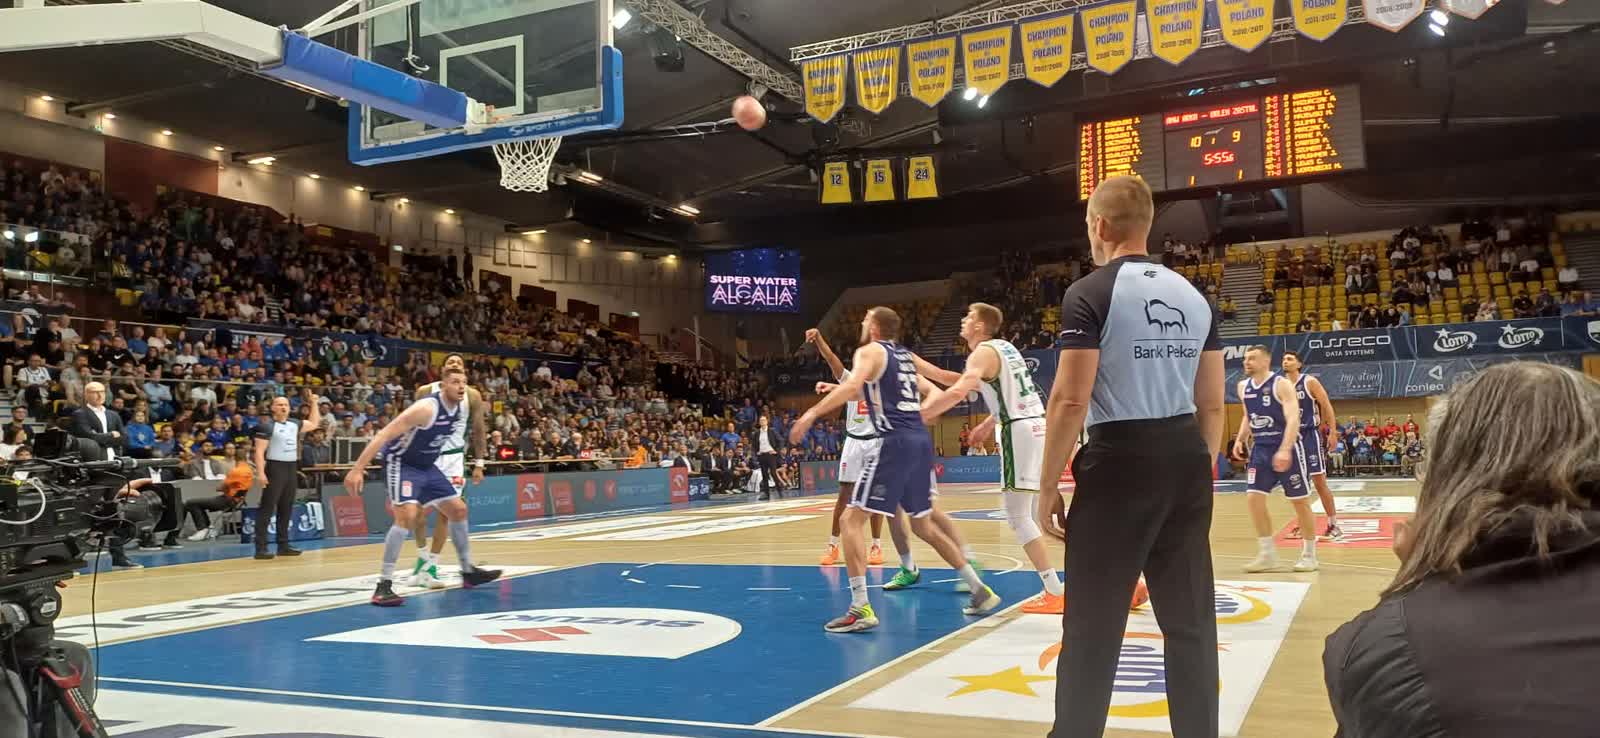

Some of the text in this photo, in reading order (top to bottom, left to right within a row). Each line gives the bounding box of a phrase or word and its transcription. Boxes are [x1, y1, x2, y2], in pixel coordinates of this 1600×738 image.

[1154, 1, 1197, 16] CHAMPION
[1230, 7, 1264, 21] POLAND
[1089, 12, 1128, 29] CHAMPION
[1160, 19, 1192, 33] POLAND
[1027, 25, 1066, 42] CHAMPION
[1096, 31, 1124, 46] POLAND
[968, 37, 1005, 52] CHAMPION
[1033, 45, 1062, 58] POLAND
[913, 47, 950, 62] CHAMPION
[973, 55, 1000, 69] POLAND
[918, 66, 945, 78] POLAND
[1190, 136, 1202, 147] 10
[1232, 130, 1241, 142] 9
[830, 174, 843, 186] 12
[874, 171, 886, 184] 15
[914, 169, 929, 180] 24
[710, 275, 797, 286] SUPER WATER
[1308, 335, 1391, 349] asseco
[1442, 334, 1468, 349] LOTTO
[1508, 331, 1535, 345] LOTTO
[1134, 344, 1198, 359] Bank Pekao
[1344, 349, 1375, 357] SYSTEMS
[1262, 395, 1271, 407] 9
[480, 614, 705, 628] SUZUKI
